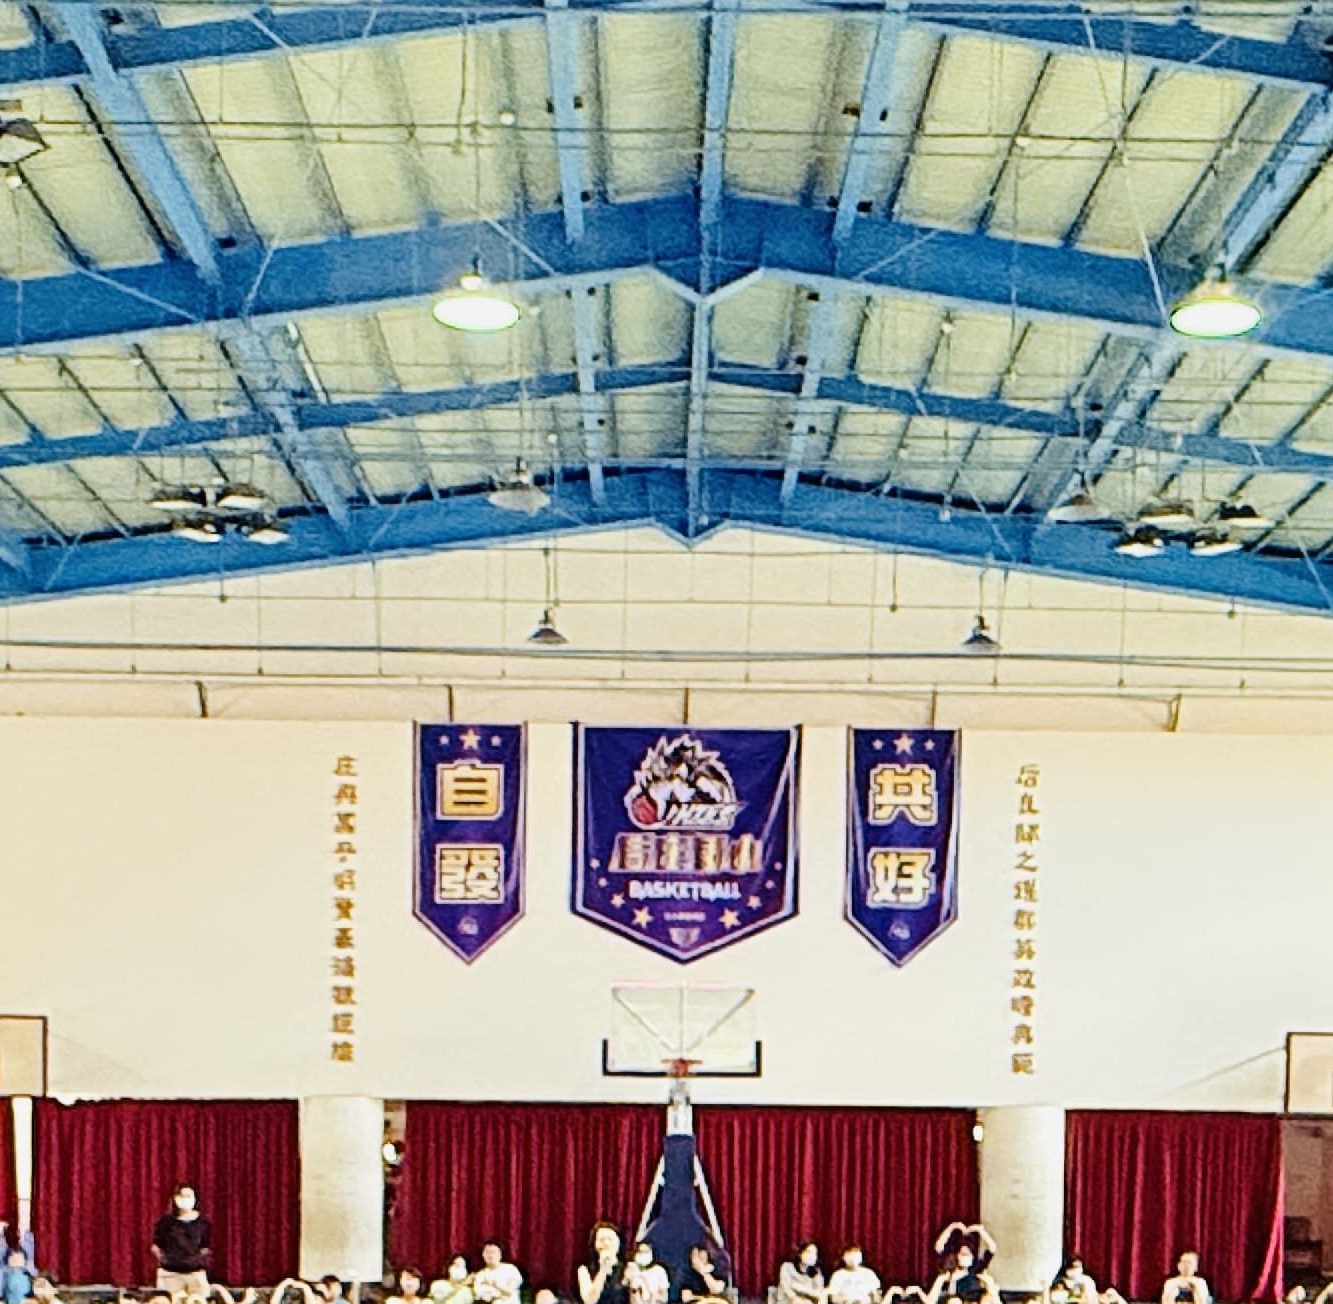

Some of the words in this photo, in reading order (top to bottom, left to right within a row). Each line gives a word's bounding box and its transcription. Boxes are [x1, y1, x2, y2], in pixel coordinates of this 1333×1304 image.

[434, 758, 504, 904] 自發
[628, 880, 742, 900] BASKETBALL
[868, 763, 938, 909] 共好
